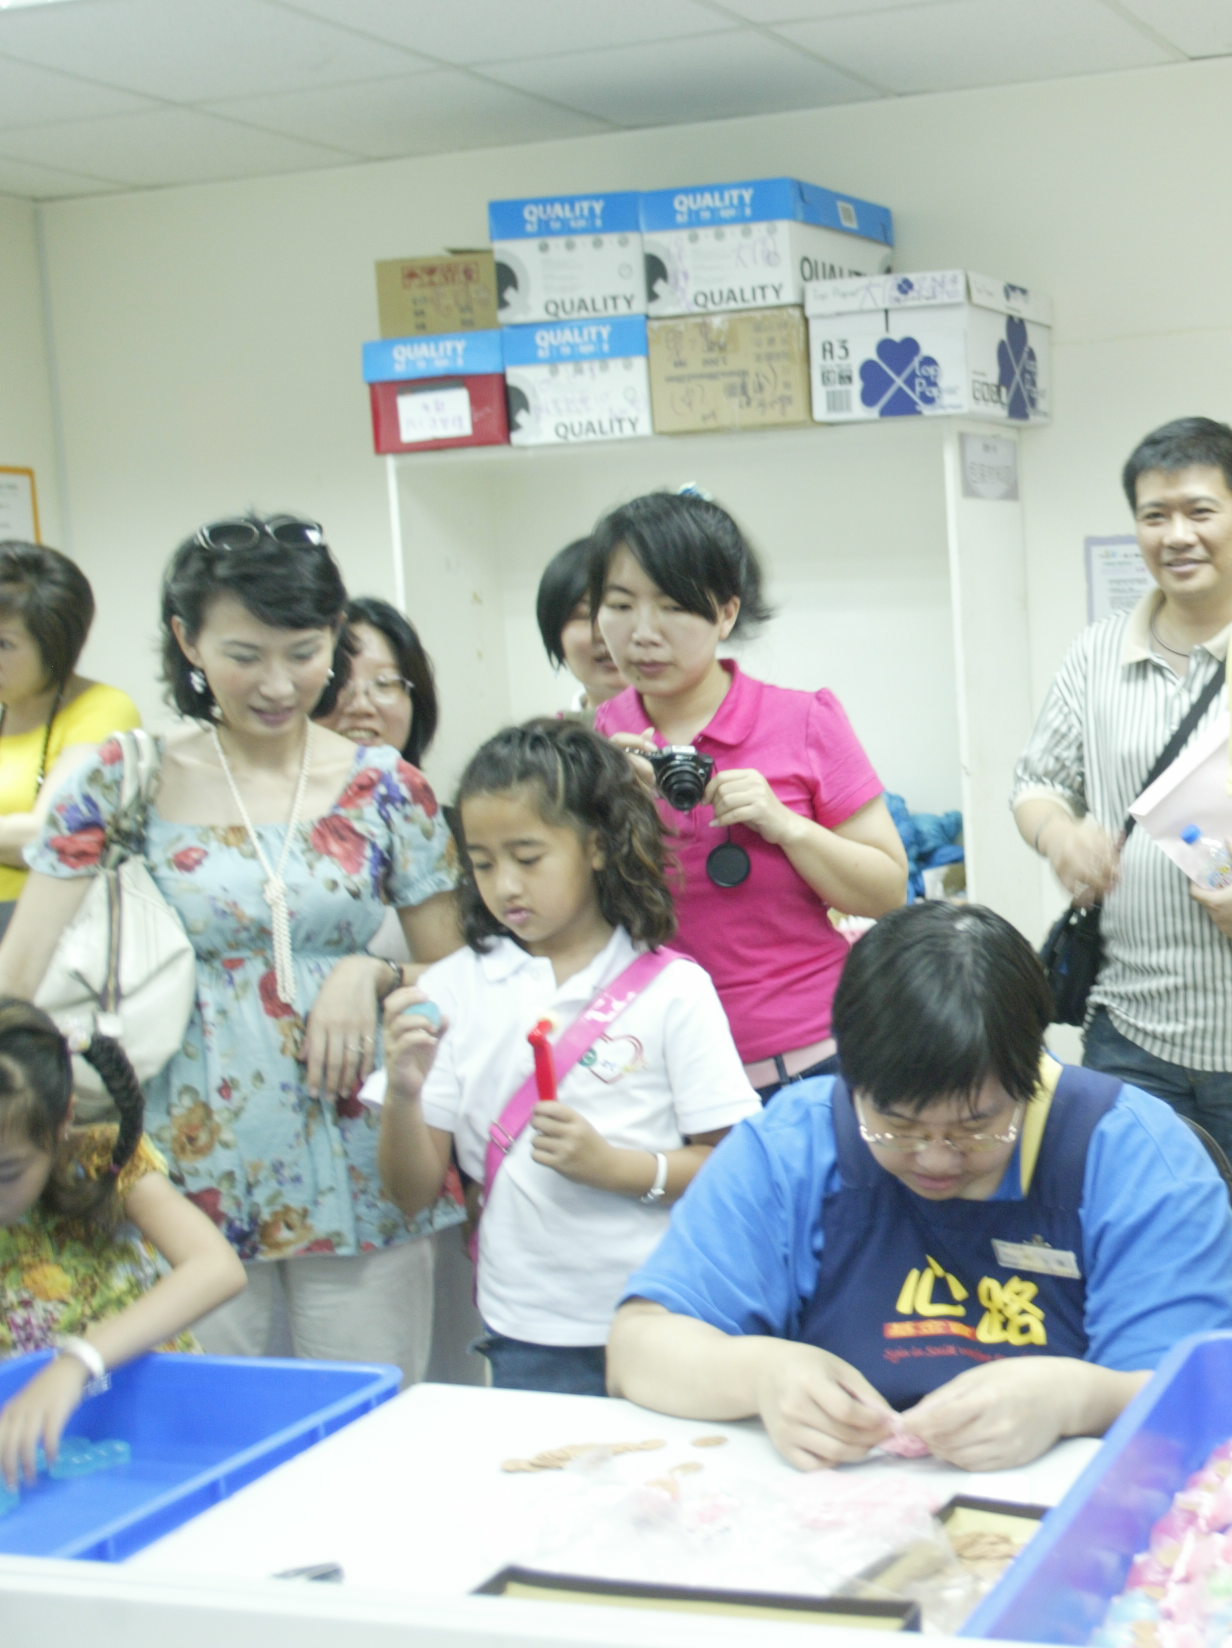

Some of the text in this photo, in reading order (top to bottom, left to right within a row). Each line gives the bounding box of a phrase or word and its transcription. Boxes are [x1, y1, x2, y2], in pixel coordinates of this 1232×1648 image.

[523, 199, 605, 221] QUALITY
[673, 188, 754, 212] QUALITY
[544, 294, 635, 317] QUALITY
[694, 283, 785, 308] QUALITY
[535, 324, 611, 348] QUALITY
[392, 340, 466, 361] QUALITY
[821, 338, 849, 361] A3
[555, 416, 640, 441] QUALITY
[896, 1254, 1047, 1346] 心路
